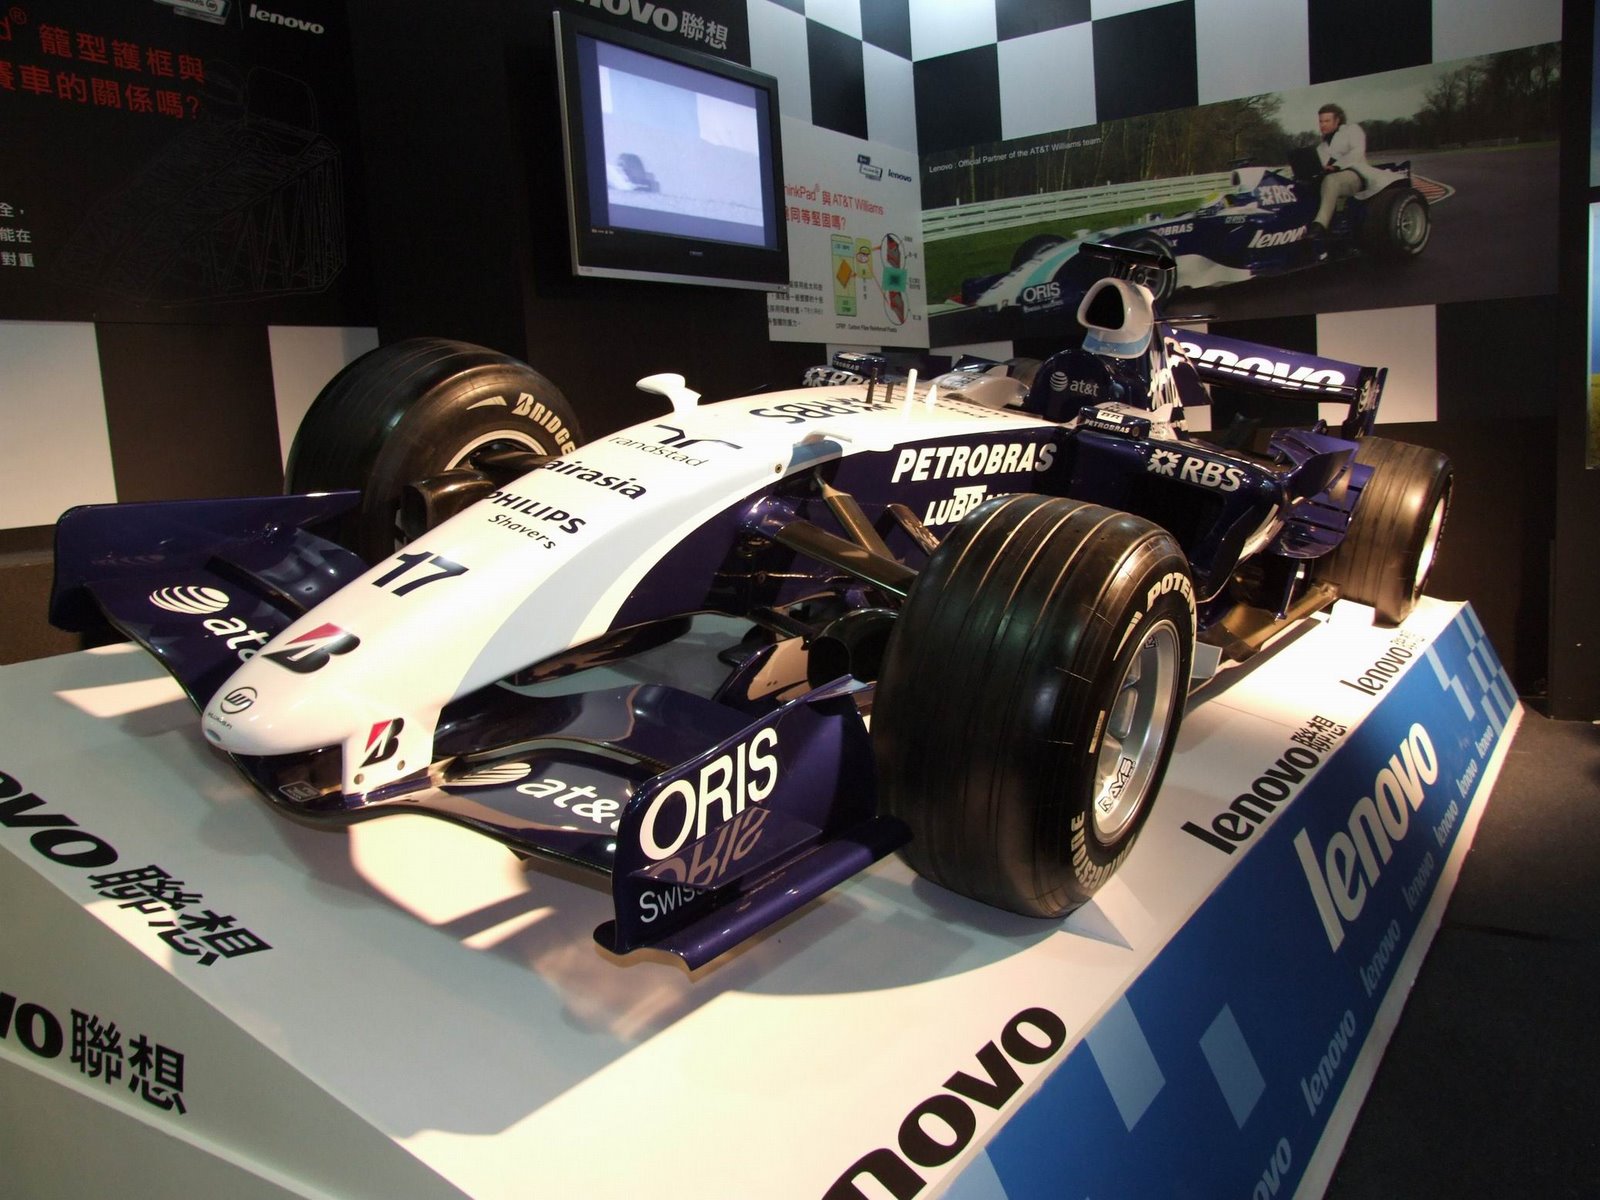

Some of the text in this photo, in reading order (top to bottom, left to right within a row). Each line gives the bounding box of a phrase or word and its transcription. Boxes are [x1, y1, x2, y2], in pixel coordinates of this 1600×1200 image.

[249, 4, 325, 35] lenovo
[680, 11, 728, 50] 聯想
[887, 168, 912, 183] lenovo
[928, 163, 953, 173] Lenovo
[958, 157, 982, 168] Official
[982, 153, 1007, 164] Partner
[1008, 150, 1016, 160] of
[1016, 148, 1028, 158] the
[1029, 144, 1050, 155] AT&T
[1050, 141, 1081, 151] Williams
[832, 194, 854, 208] AT&T
[1272, 184, 1297, 205] RBS
[1155, 223, 1194, 236] OBRAS
[1022, 282, 1061, 302] ORIS
[1070, 378, 1100, 398] at&t
[1083, 418, 1131, 434] PETROBRAS
[608, 435, 710, 467] randstad
[891, 442, 1057, 484] PETROBRAS
[542, 459, 647, 500] airasia
[1179, 456, 1246, 493] RBS
[487, 513, 557, 551] Shavers
[372, 551, 470, 597] 17
[1339, 646, 1414, 696] lenovo
[639, 726, 779, 861] ORIS
[1455, 758, 1479, 799] lenovo
[516, 778, 620, 832] at&
[1180, 746, 1320, 855] lenovo
[1293, 722, 1439, 953] lenovo
[1432, 800, 1459, 848] lenovo
[1402, 851, 1435, 912] lenovo
[87, 864, 274, 966] 聯想
[1359, 919, 1401, 998] lenovo
[69, 1008, 188, 1115] 聯想
[1300, 1009, 1357, 1117] lenovo
[1253, 1136, 1292, 1200] ovo
